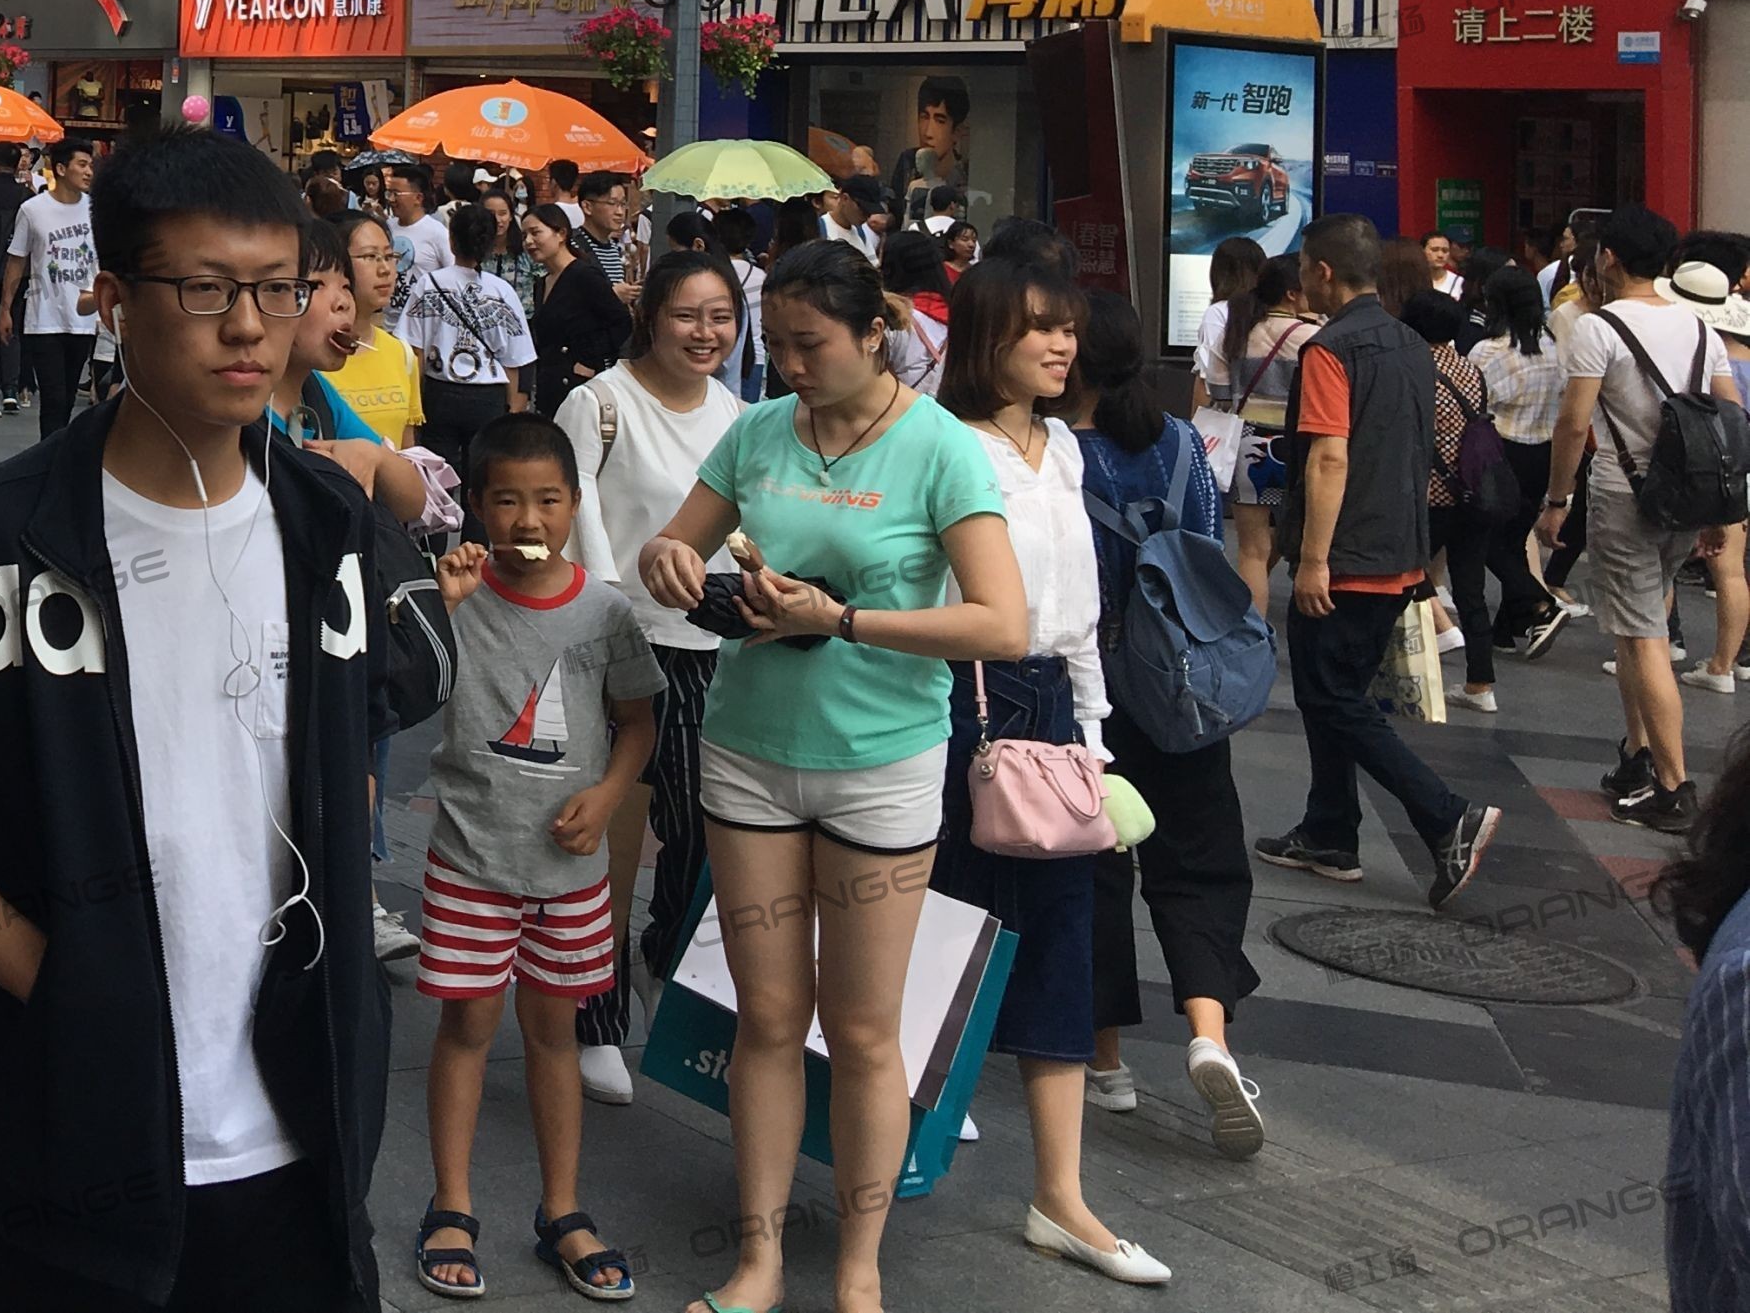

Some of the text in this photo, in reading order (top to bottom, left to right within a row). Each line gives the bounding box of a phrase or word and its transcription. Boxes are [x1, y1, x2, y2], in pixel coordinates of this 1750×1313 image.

[1452, 4, 1595, 45] 请上二楼
[1191, 83, 1293, 116] 新一代 智跑
[356, 391, 406, 407] GUCCI
